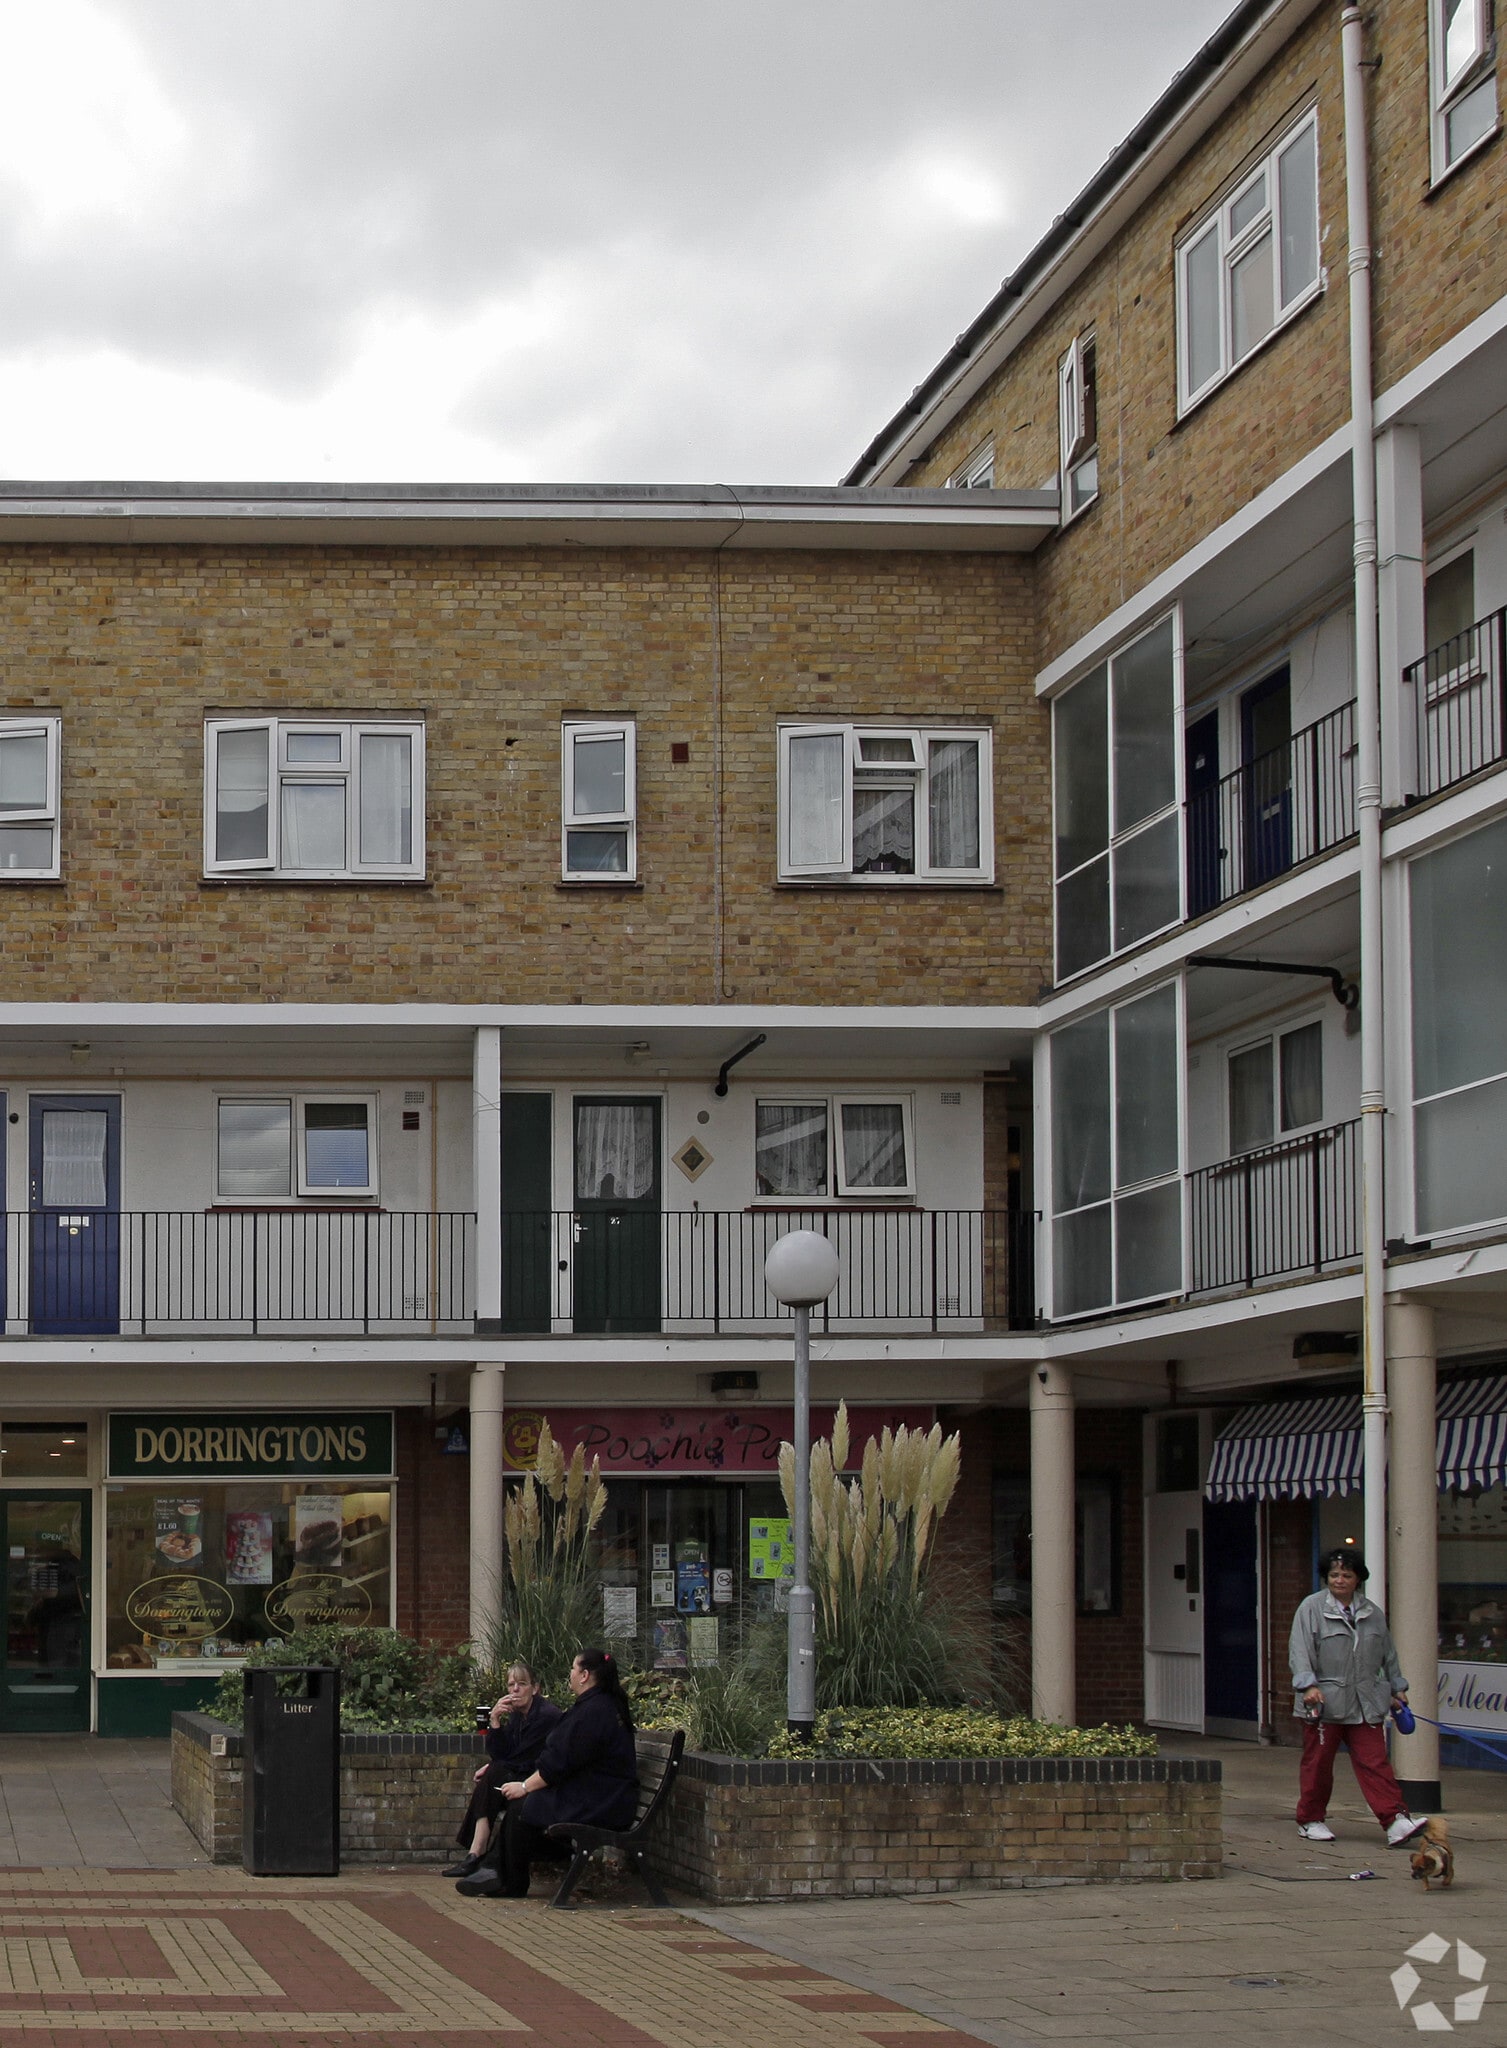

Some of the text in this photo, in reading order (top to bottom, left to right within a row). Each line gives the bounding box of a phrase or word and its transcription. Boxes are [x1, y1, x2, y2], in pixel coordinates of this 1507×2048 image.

[134, 1426, 367, 1463] DORRINGTONS
[573, 1421, 724, 1461] Poochie
[41, 1532, 61, 1541] OPEN
[134, 1601, 222, 1621] Dorringtons
[271, 1601, 360, 1621] Dorringtons
[284, 1703, 313, 1713] Litter
